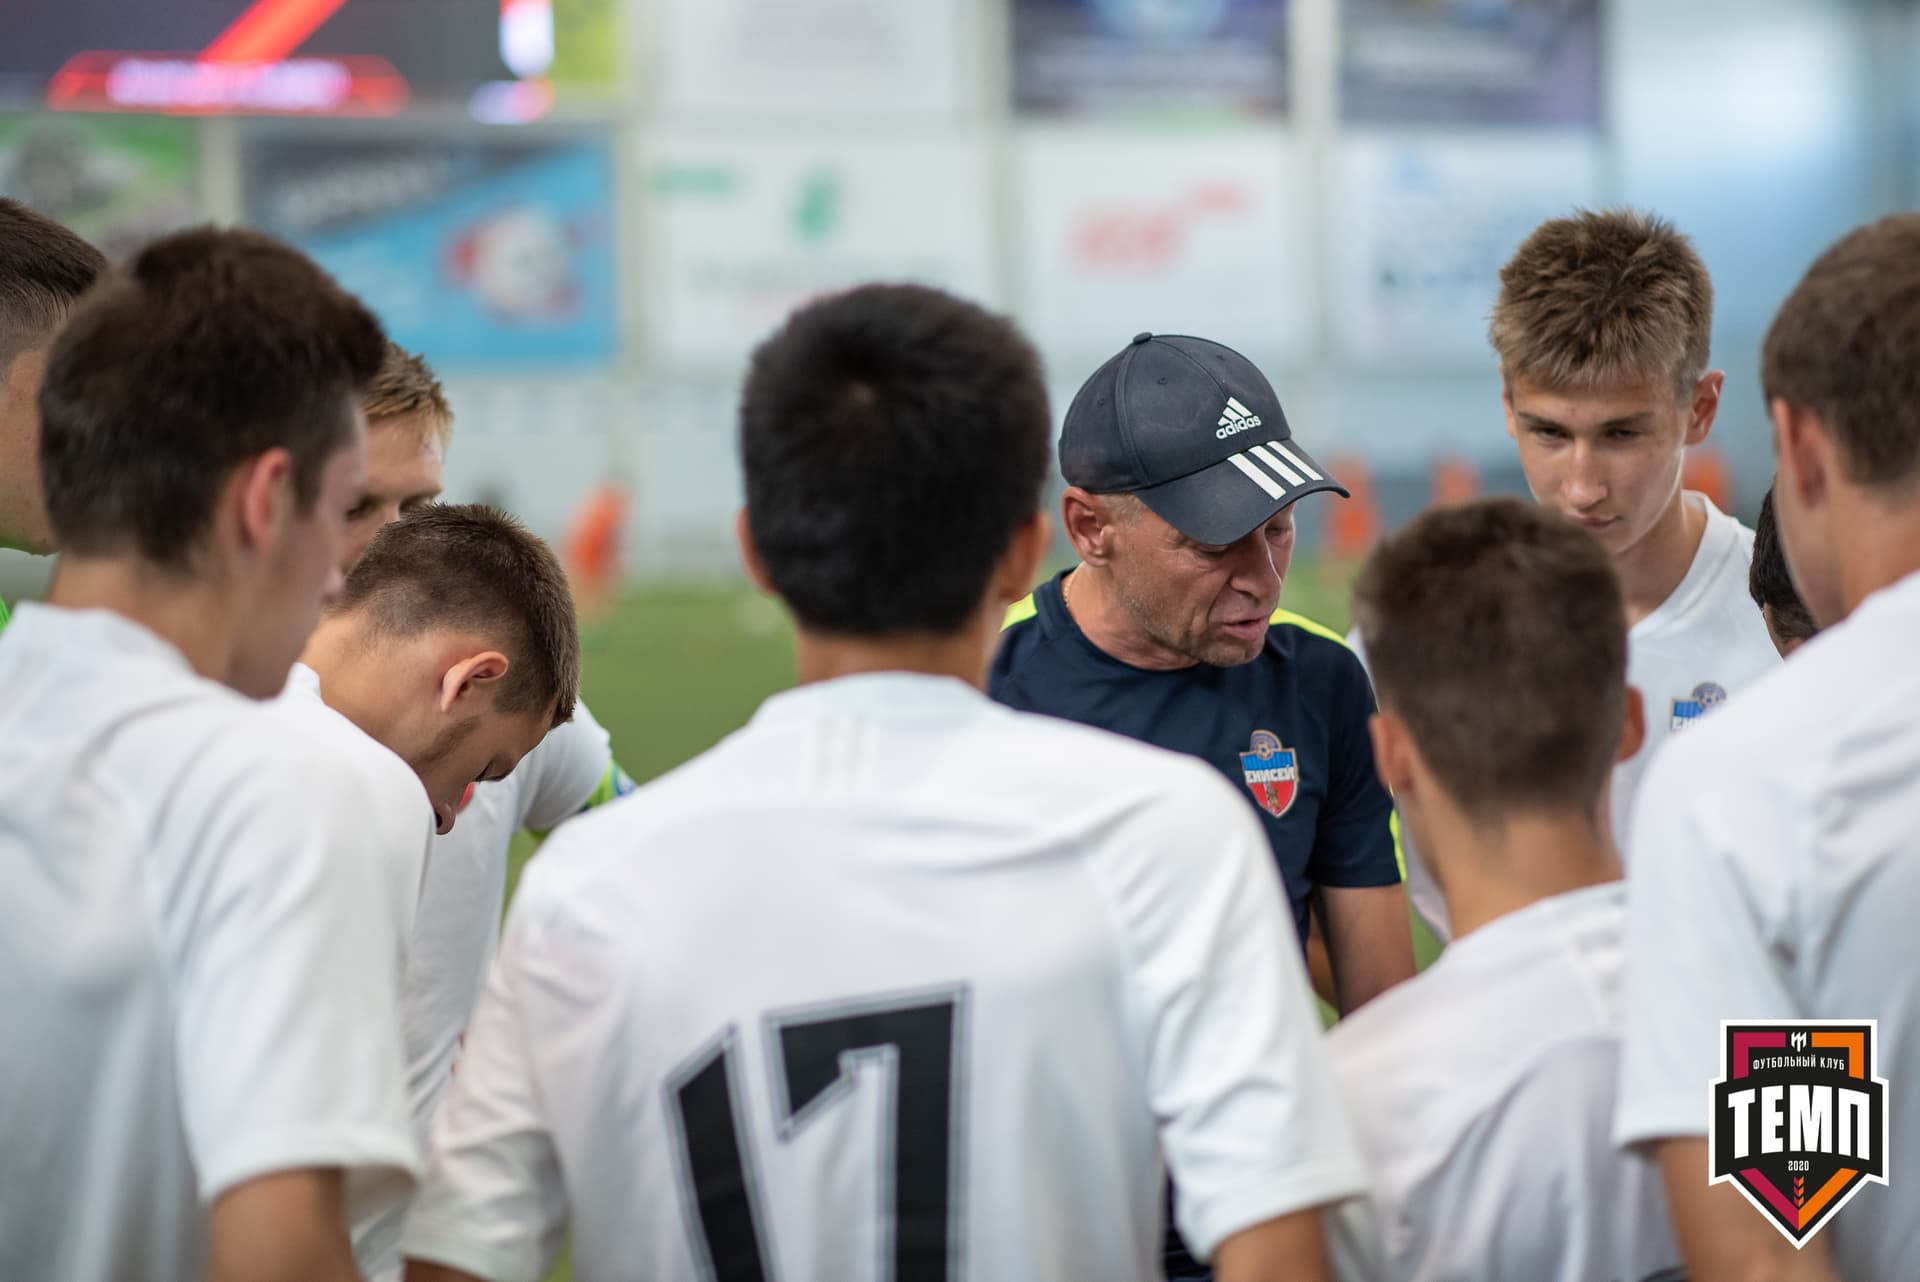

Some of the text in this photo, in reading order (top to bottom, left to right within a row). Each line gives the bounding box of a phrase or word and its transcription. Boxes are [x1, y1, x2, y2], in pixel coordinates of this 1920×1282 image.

[1215, 415, 1262, 440] adidas
[1244, 764, 1295, 783] ЕНИСЕЙ
[660, 980, 972, 1282] 17
